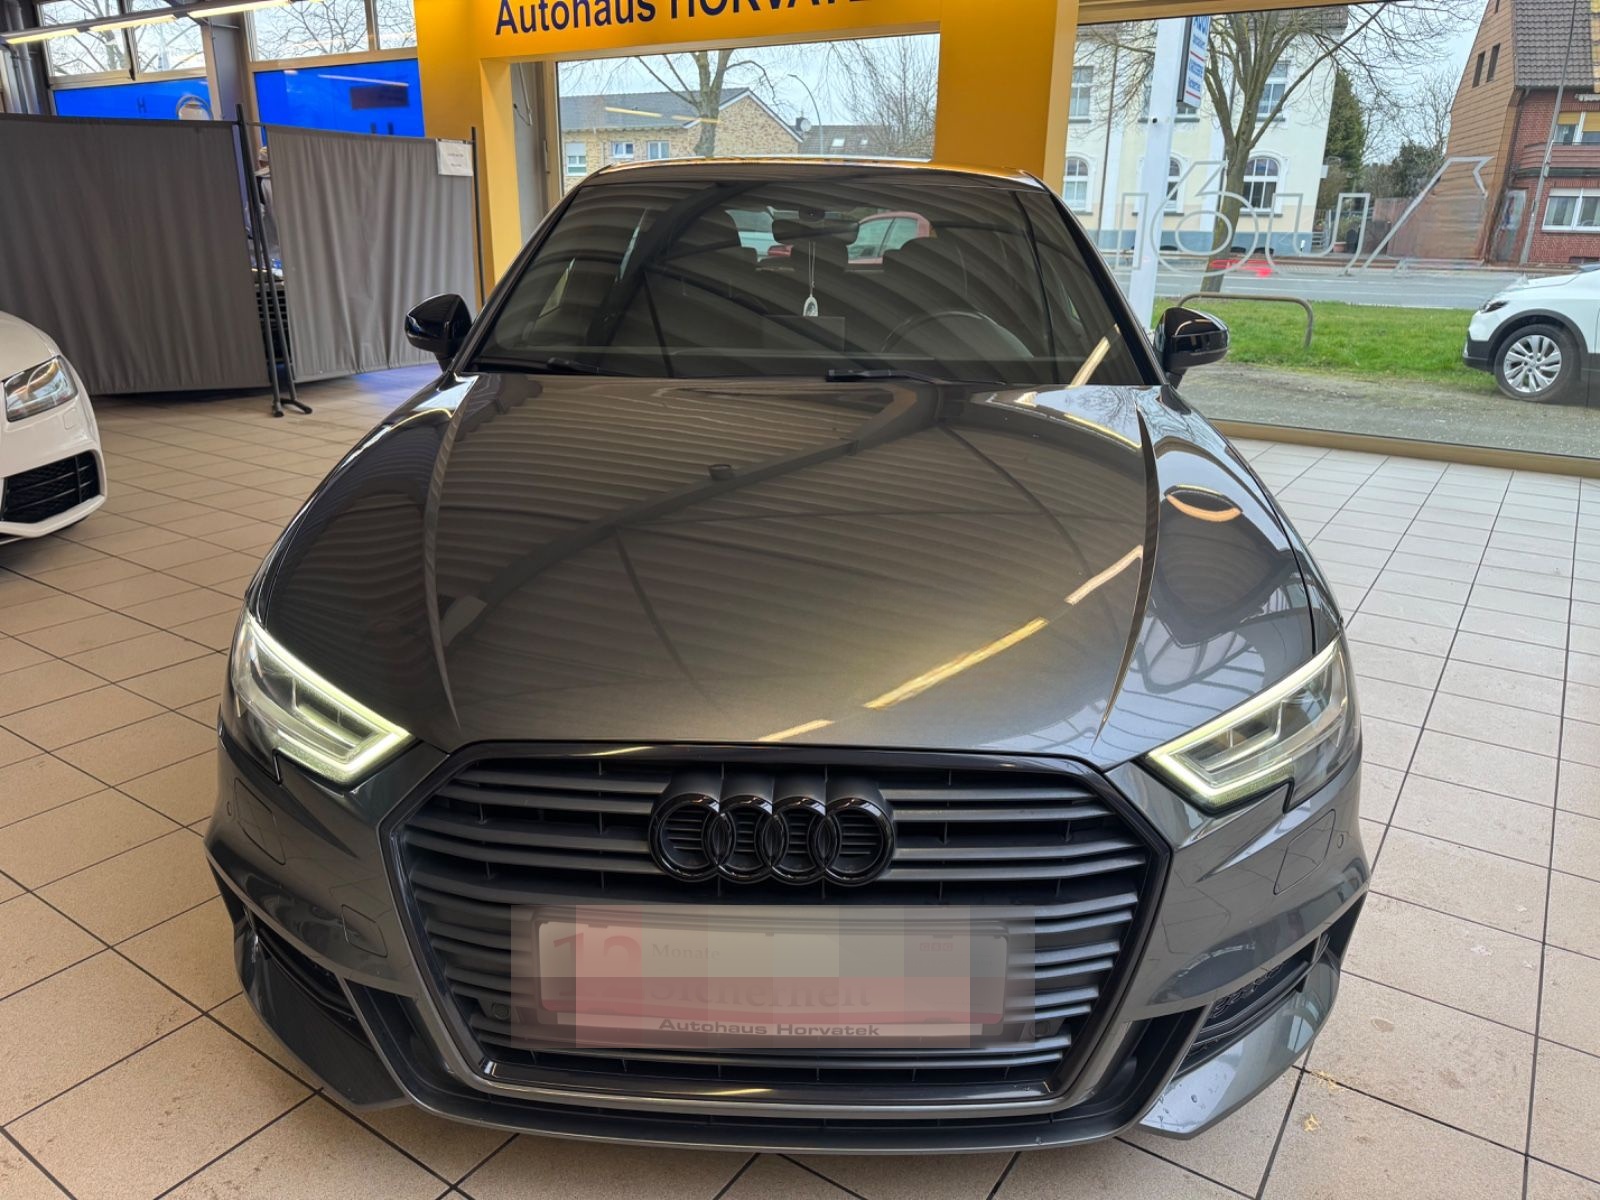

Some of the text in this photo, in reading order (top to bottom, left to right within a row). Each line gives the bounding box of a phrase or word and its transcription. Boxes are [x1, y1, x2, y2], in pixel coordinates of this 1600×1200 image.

[495, 0, 656, 36] Autohaus
[652, 943, 720, 961] Monate
[659, 1018, 880, 1036] Autohaus Horvatek
